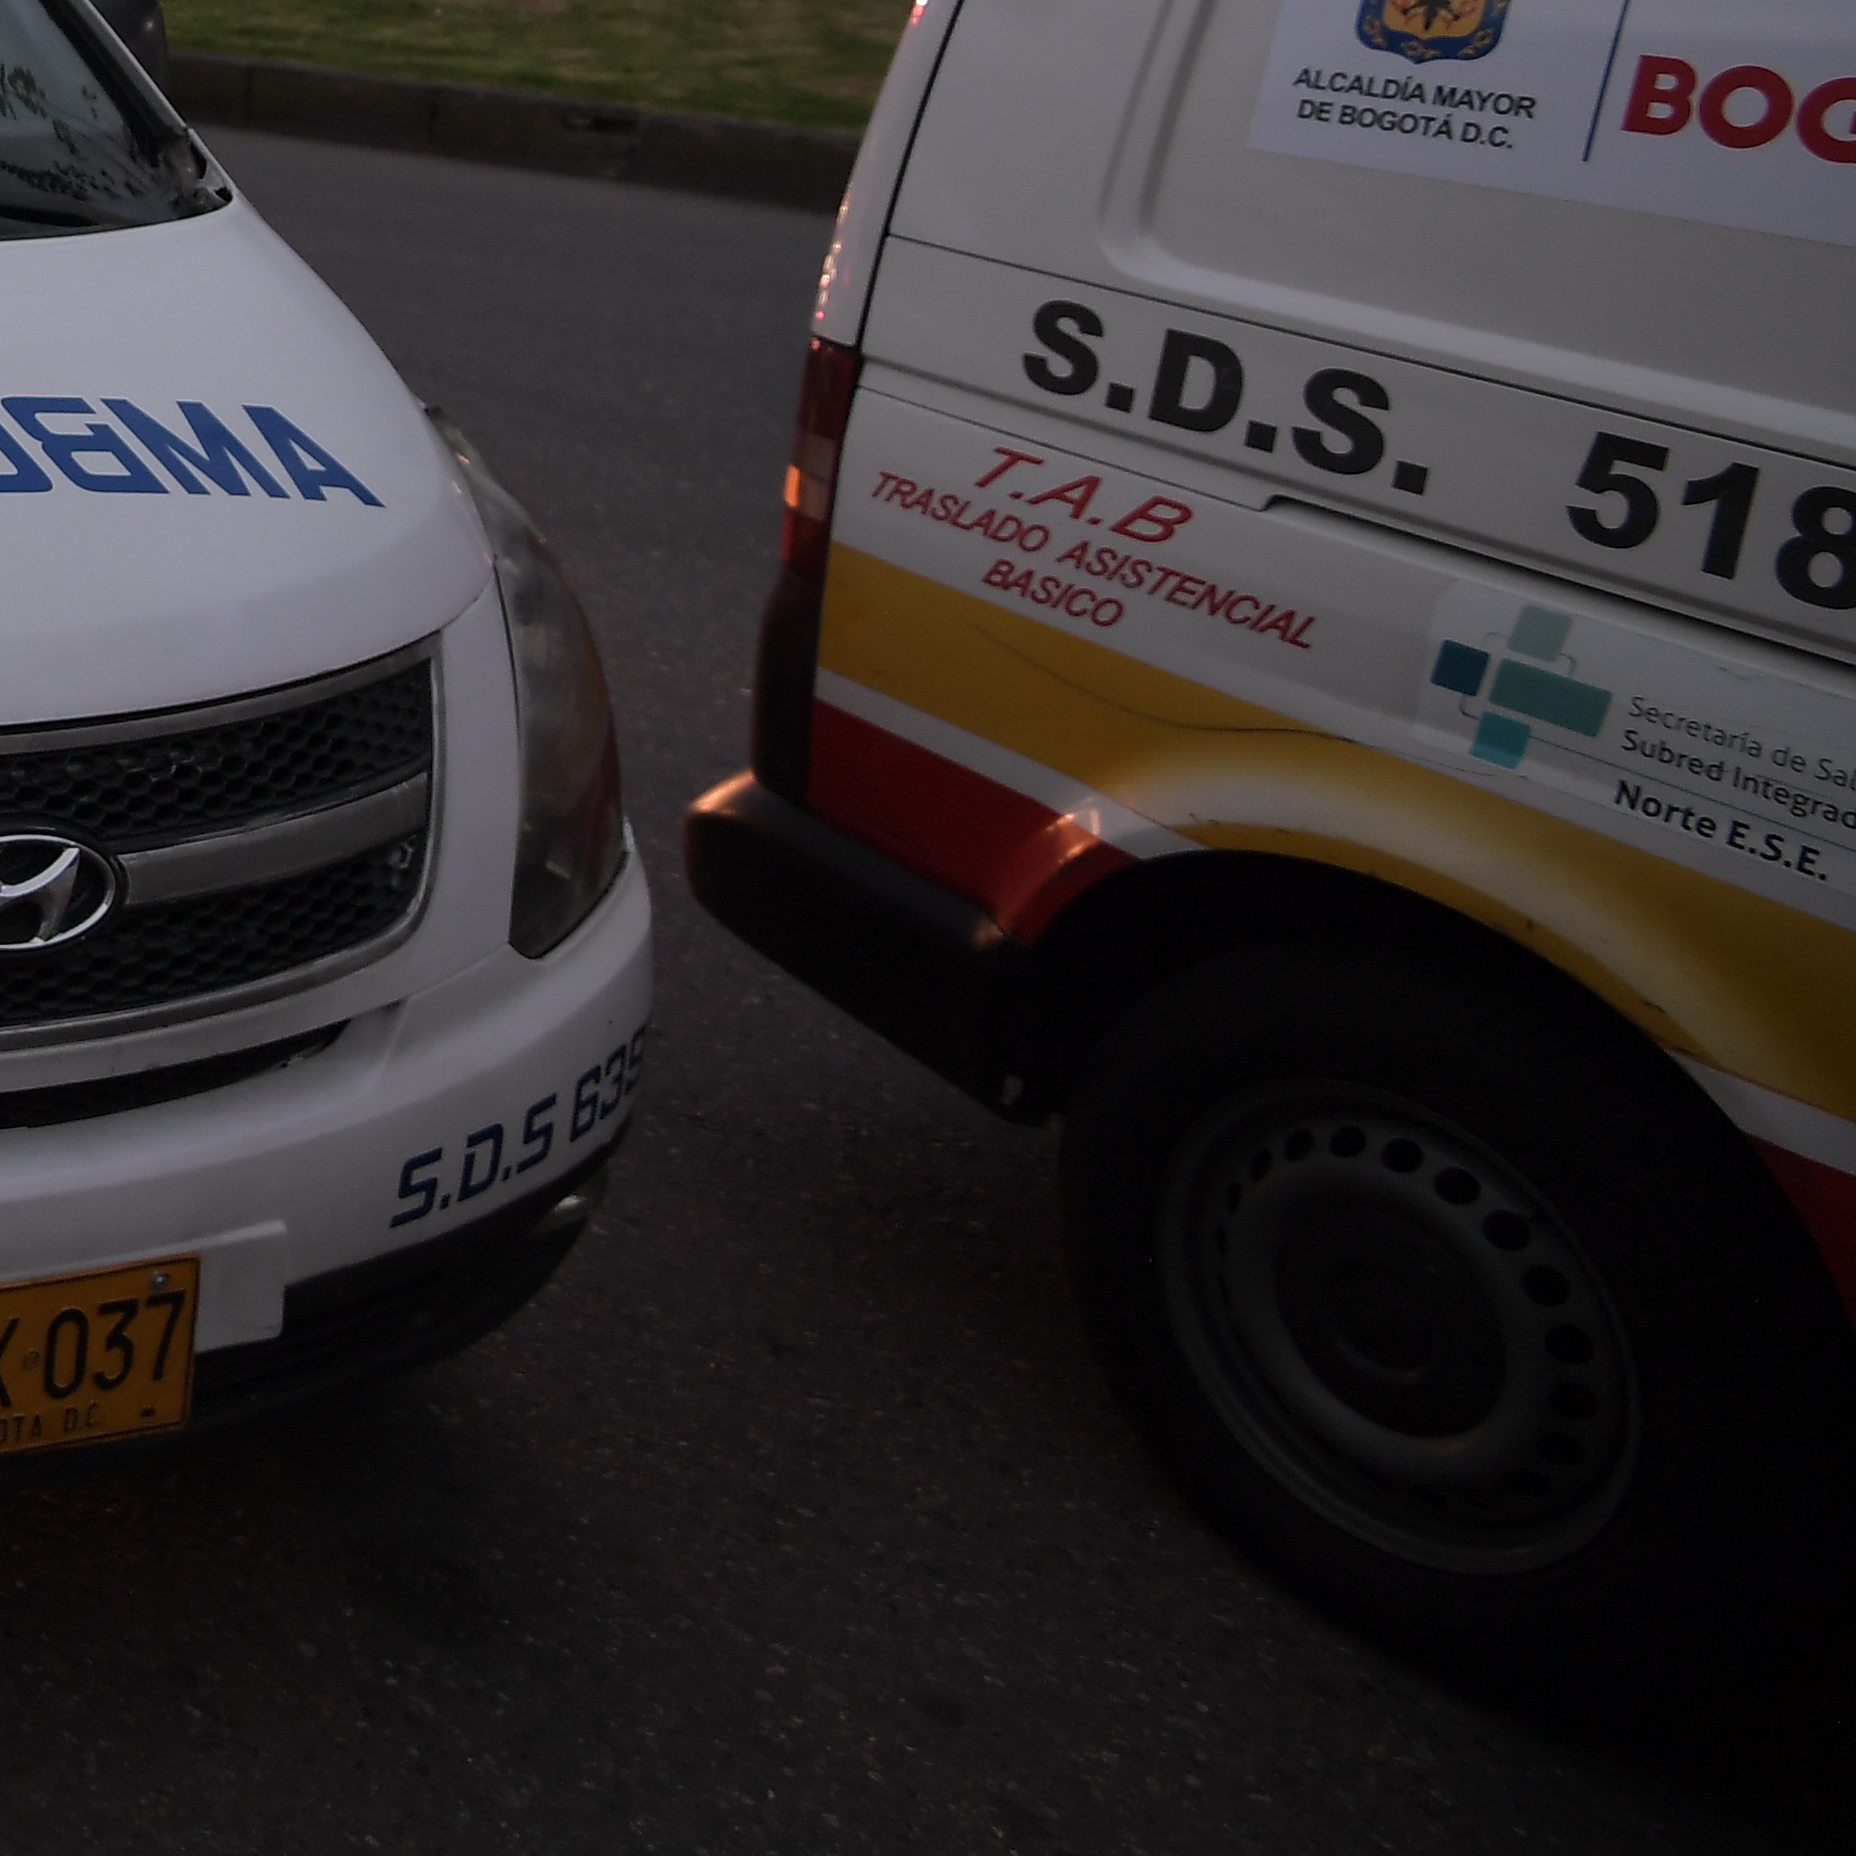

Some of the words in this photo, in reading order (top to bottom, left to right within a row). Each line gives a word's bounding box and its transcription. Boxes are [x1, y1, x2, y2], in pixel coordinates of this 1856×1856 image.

[1293, 67, 1426, 104] ALCALDÍA
[1432, 84, 1536, 119] MAYOR
[1297, 99, 1333, 122] DE
[1338, 104, 1453, 140] BOGOTÁ
[1460, 122, 1513, 148] D.C.
[975, 447, 1193, 543] T.A.B
[1023, 299, 1429, 495] S.D.S.
[1566, 430, 1856, 610] 518
[872, 471, 1050, 552] TRASLADO
[1056, 540, 1316, 649] ASISTENCIAL
[982, 558, 1124, 627] BASICO
[1621, 729, 1725, 782] Subred
[1628, 696, 1762, 758] Secretaría
[1771, 747, 1807, 773] de
[1615, 779, 1716, 839] Norte
[1727, 820, 1828, 881] E.S.E.
[390, 1094, 556, 1228] S.D.S
[43, 1289, 187, 1399] 037
